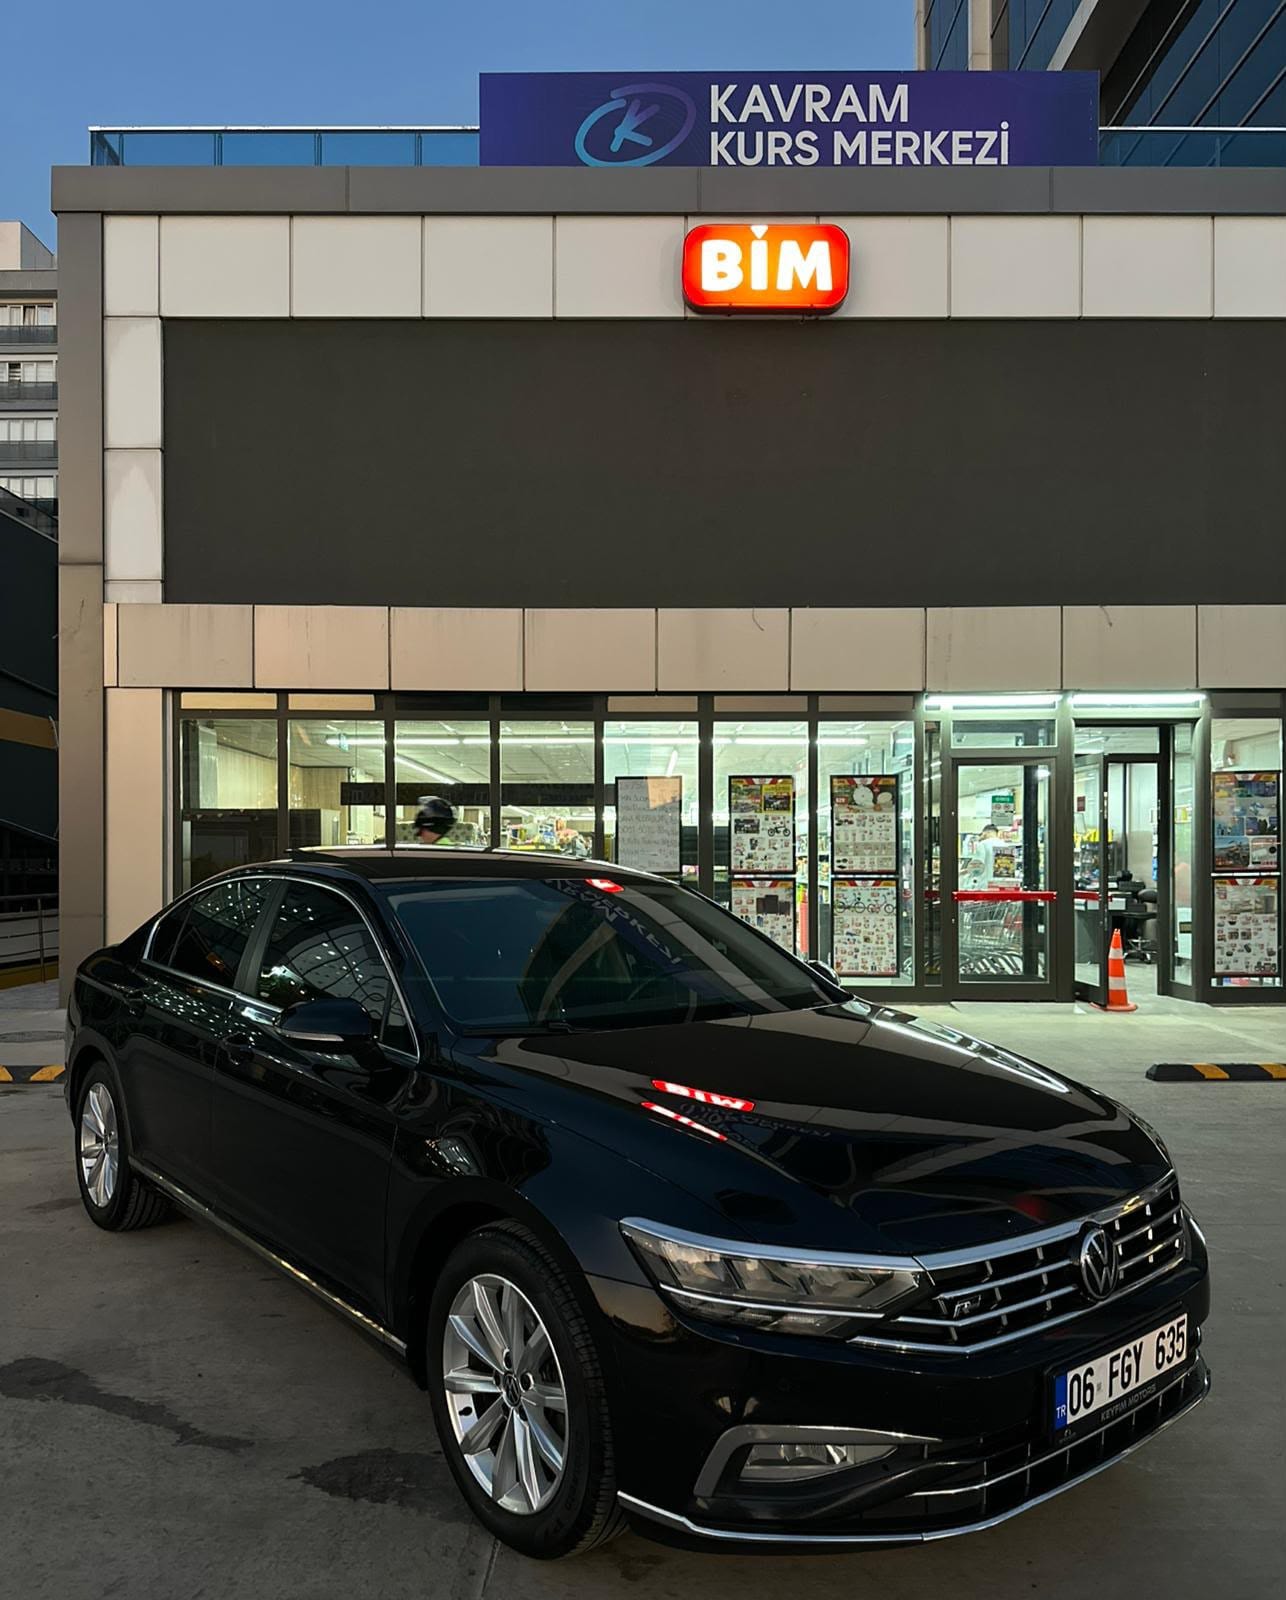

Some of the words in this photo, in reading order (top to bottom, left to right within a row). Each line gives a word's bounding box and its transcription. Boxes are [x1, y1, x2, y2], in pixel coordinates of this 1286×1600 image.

[710, 84, 909, 123] KAVRAM
[710, 130, 820, 166] KURS
[833, 121, 1009, 165] MERKEZİ
[701, 225, 833, 291] BİM
[1056, 1404, 1067, 1419] TR
[1069, 1367, 1095, 1417] 06
[1109, 1341, 1144, 1398] FGY
[1155, 1319, 1186, 1371] 635
